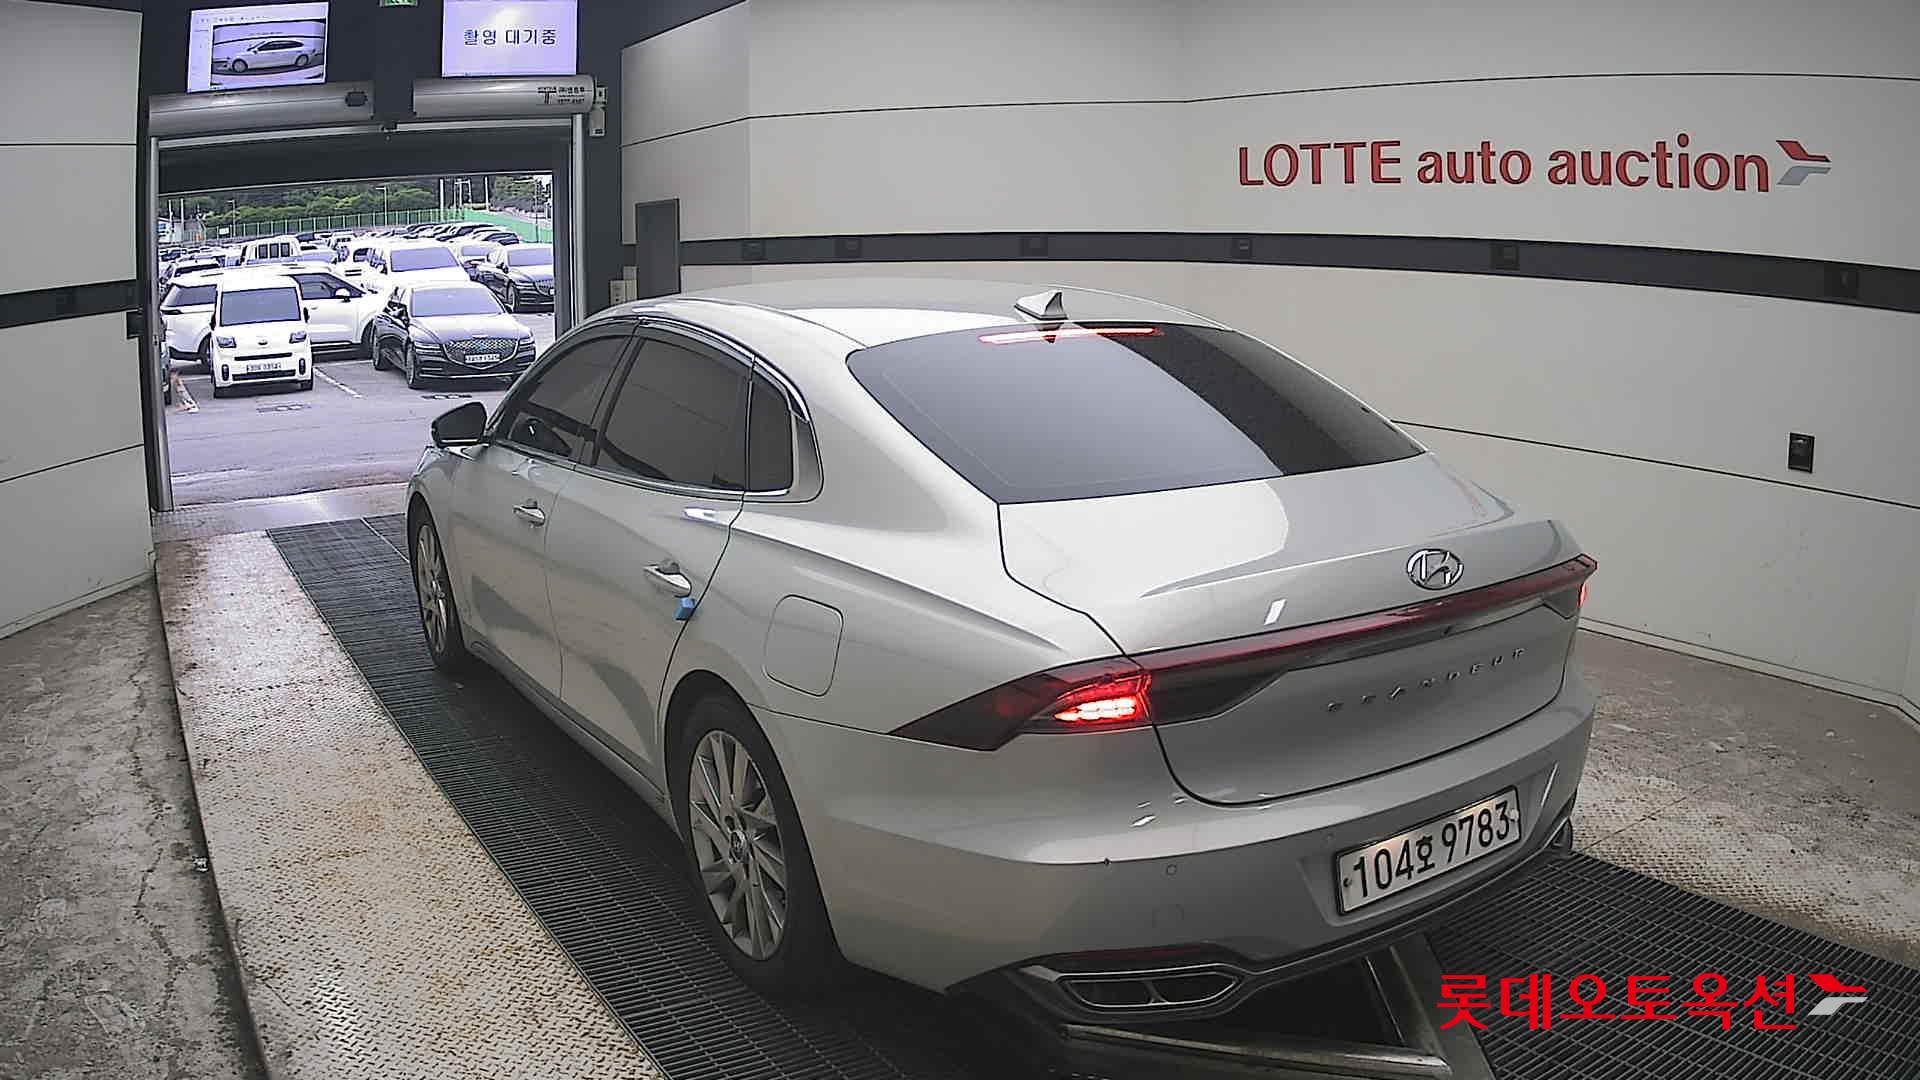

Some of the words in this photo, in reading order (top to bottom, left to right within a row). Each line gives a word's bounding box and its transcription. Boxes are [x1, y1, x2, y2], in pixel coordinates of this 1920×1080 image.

[463, 28, 497, 46] 촬영
[504, 28, 557, 45] 대기중
[1239, 140, 1401, 188] LOTTE
[1417, 140, 1532, 186] auto
[1547, 133, 1770, 193] auction
[1326, 647, 1526, 712] DEUR
[1353, 834, 1436, 898] 104호
[1441, 799, 1510, 864] 9783
